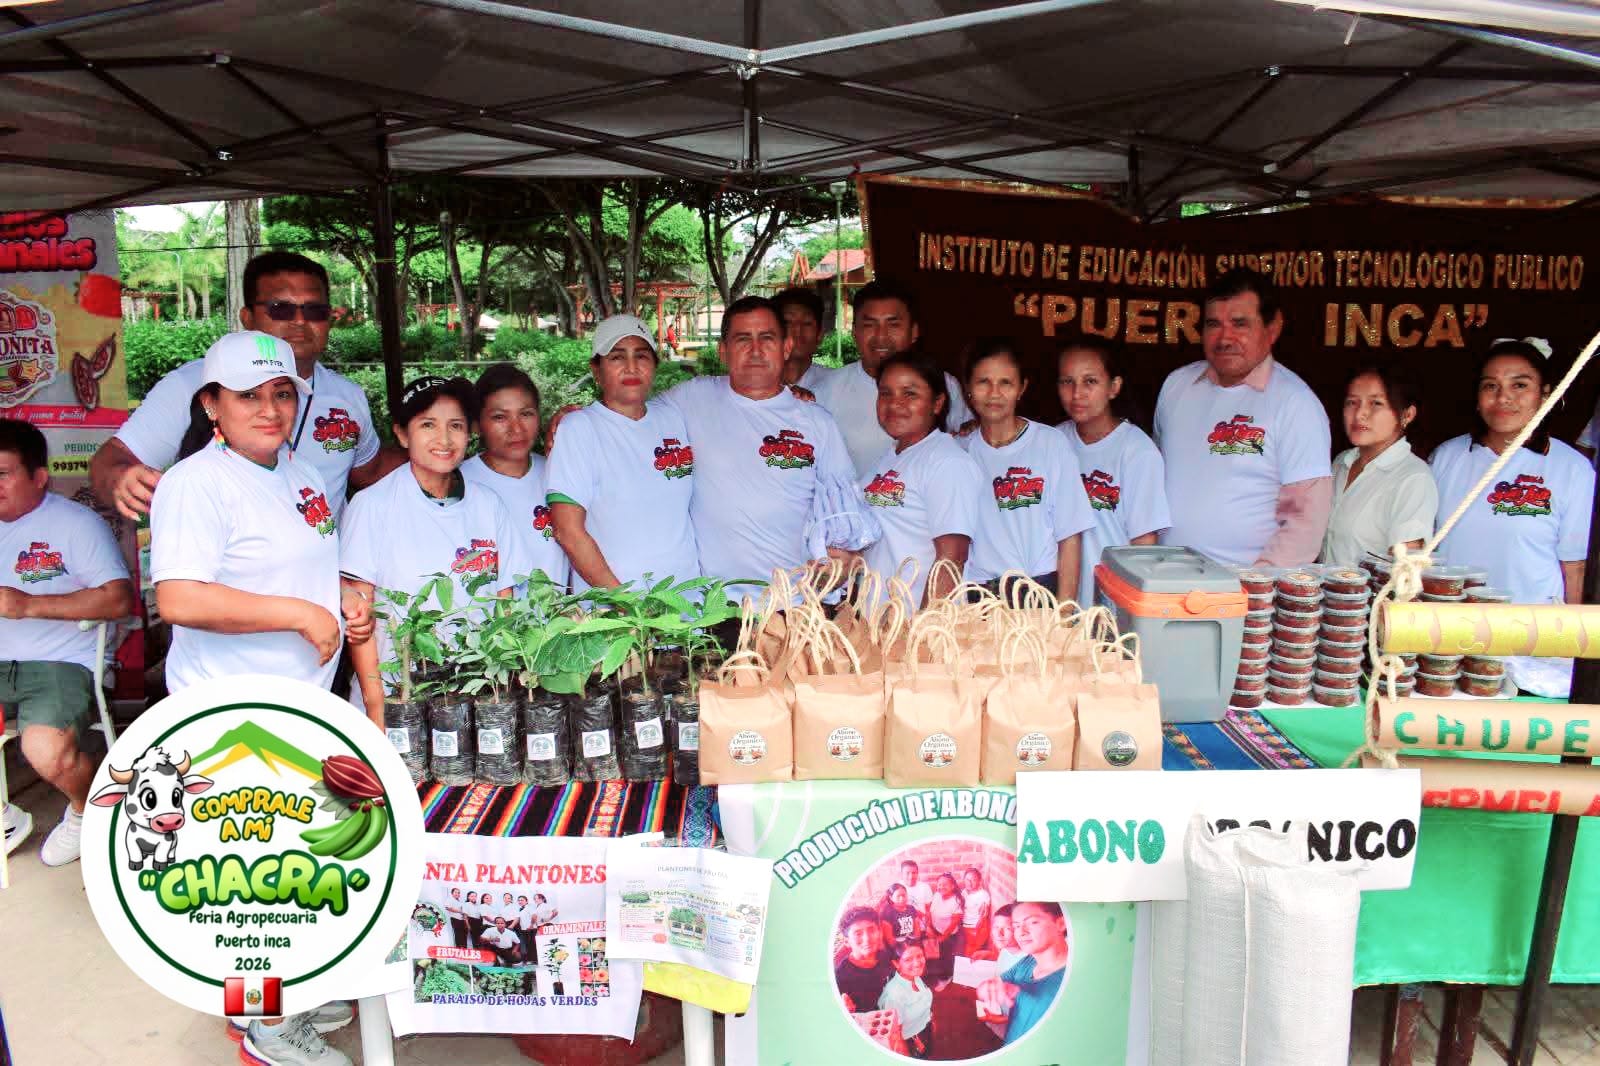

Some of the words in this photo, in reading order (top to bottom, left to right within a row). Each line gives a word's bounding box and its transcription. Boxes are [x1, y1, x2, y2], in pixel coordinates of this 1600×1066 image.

[919, 232, 1034, 277] INSTITUTO
[1041, 243, 1070, 280] DE
[1078, 244, 1206, 288] EDUCACIÓN
[1334, 250, 1484, 288] TECNOLOGICO
[1494, 254, 1584, 289] PUBLICO
[1013, 293, 1202, 344] “PUER
[773, 799, 907, 889] PRODUCIÓN
[904, 791, 938, 825] DE
[1017, 818, 1166, 865] ABONO
[475, 864, 607, 884] PLANTONES
[436, 946, 481, 960] FRUTALES
[486, 996, 504, 1006] DE
[506, 995, 547, 1006] HOJAS
[551, 996, 598, 1006] VERDES
